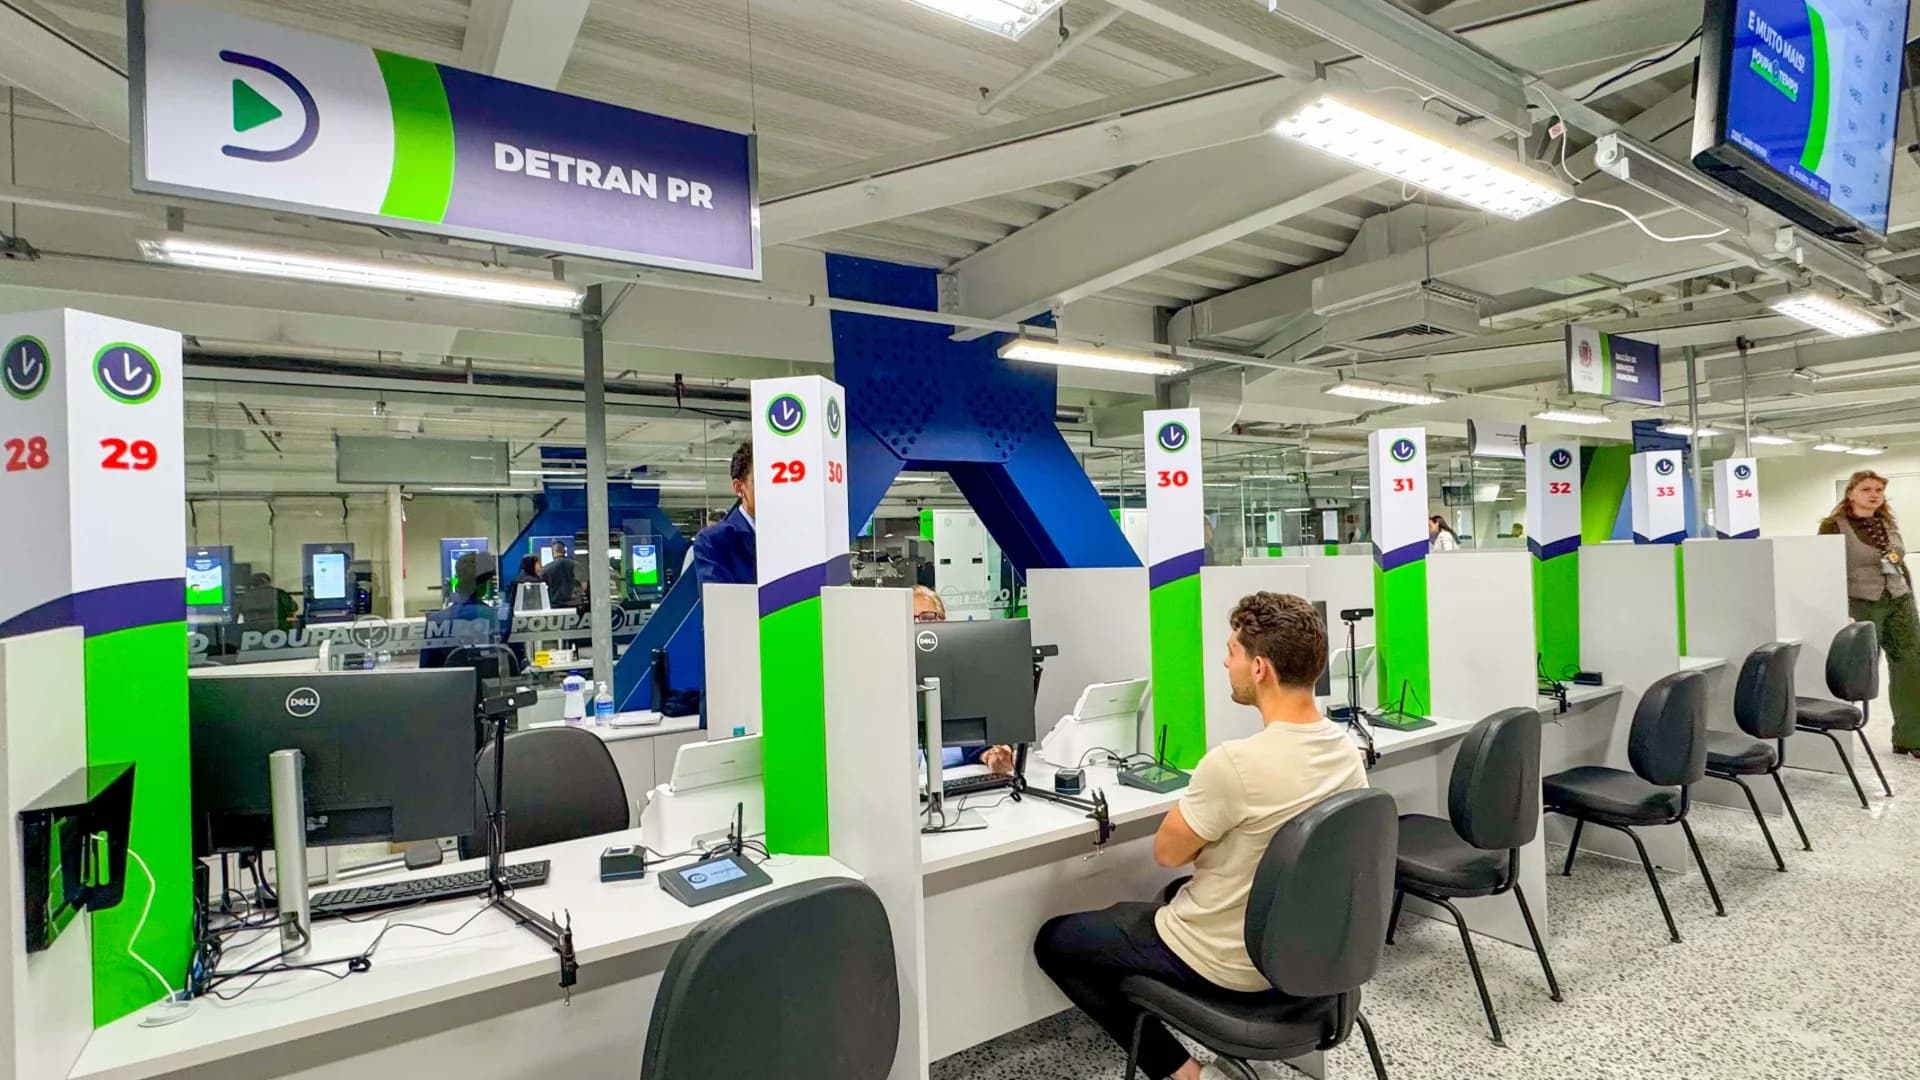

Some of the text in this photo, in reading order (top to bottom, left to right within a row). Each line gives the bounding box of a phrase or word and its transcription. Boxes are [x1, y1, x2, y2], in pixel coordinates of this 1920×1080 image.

[1755, 16, 1783, 54] MUITO
[494, 142, 713, 209] DETRAN PR
[4, 436, 49, 472] 28
[99, 438, 157, 470] 29
[771, 460, 806, 484] 29
[828, 460, 843, 484] 30
[1157, 470, 1188, 487] 30
[1393, 478, 1413, 491] 31
[1550, 482, 1571, 494] 32
[1656, 487, 1675, 497] 33
[1736, 489, 1752, 498] 34
[511, 612, 592, 632] POUPA
[241, 626, 351, 651] POUPA
[290, 697, 316, 706] DELL
